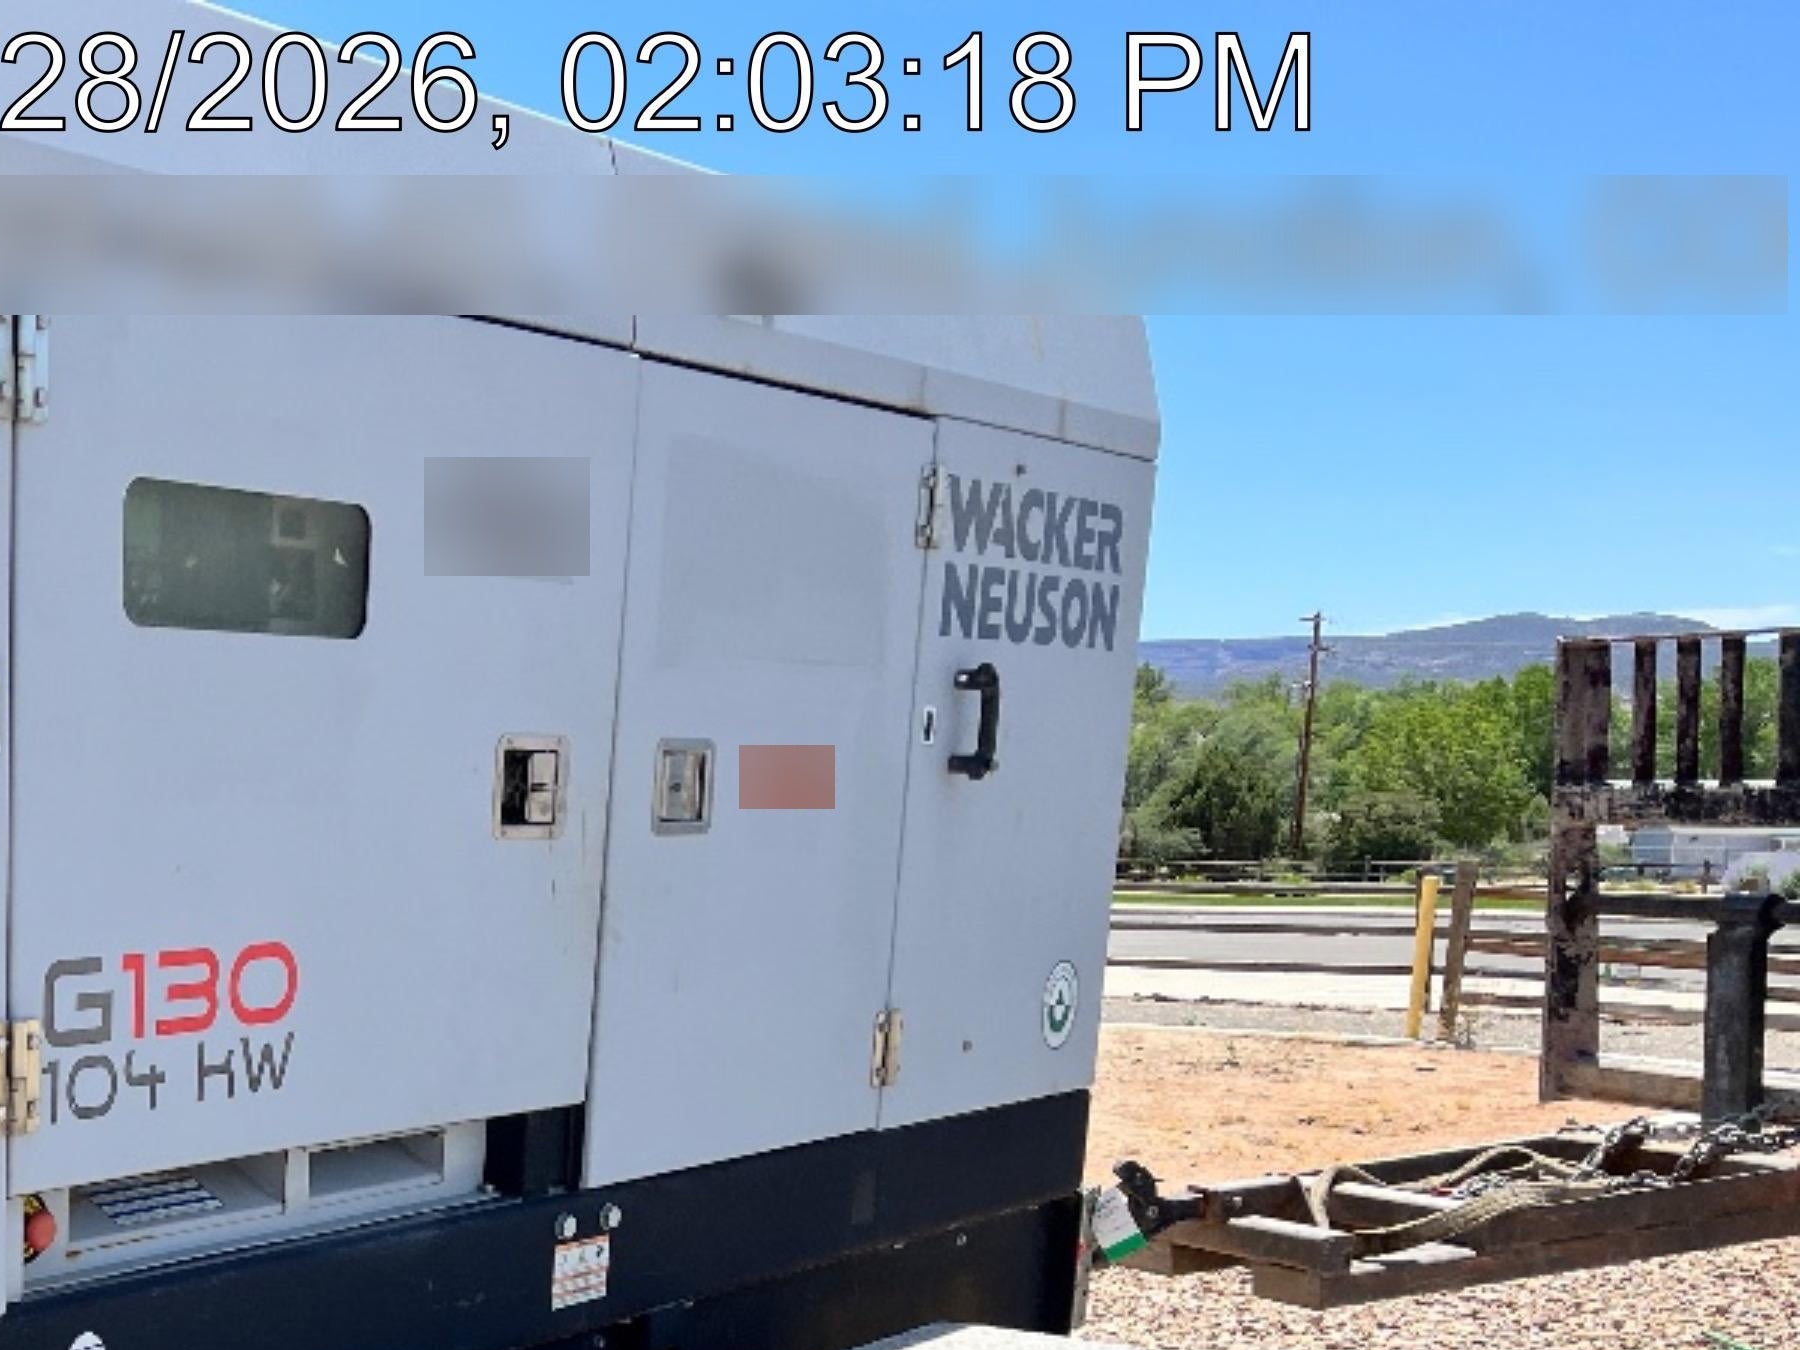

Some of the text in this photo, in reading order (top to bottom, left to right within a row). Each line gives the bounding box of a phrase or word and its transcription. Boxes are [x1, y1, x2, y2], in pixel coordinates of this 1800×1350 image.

[948, 473, 1123, 574] WACKER
[938, 560, 1120, 652] NEUSON
[44, 940, 298, 1048] G130
[41, 1048, 166, 1125] 104
